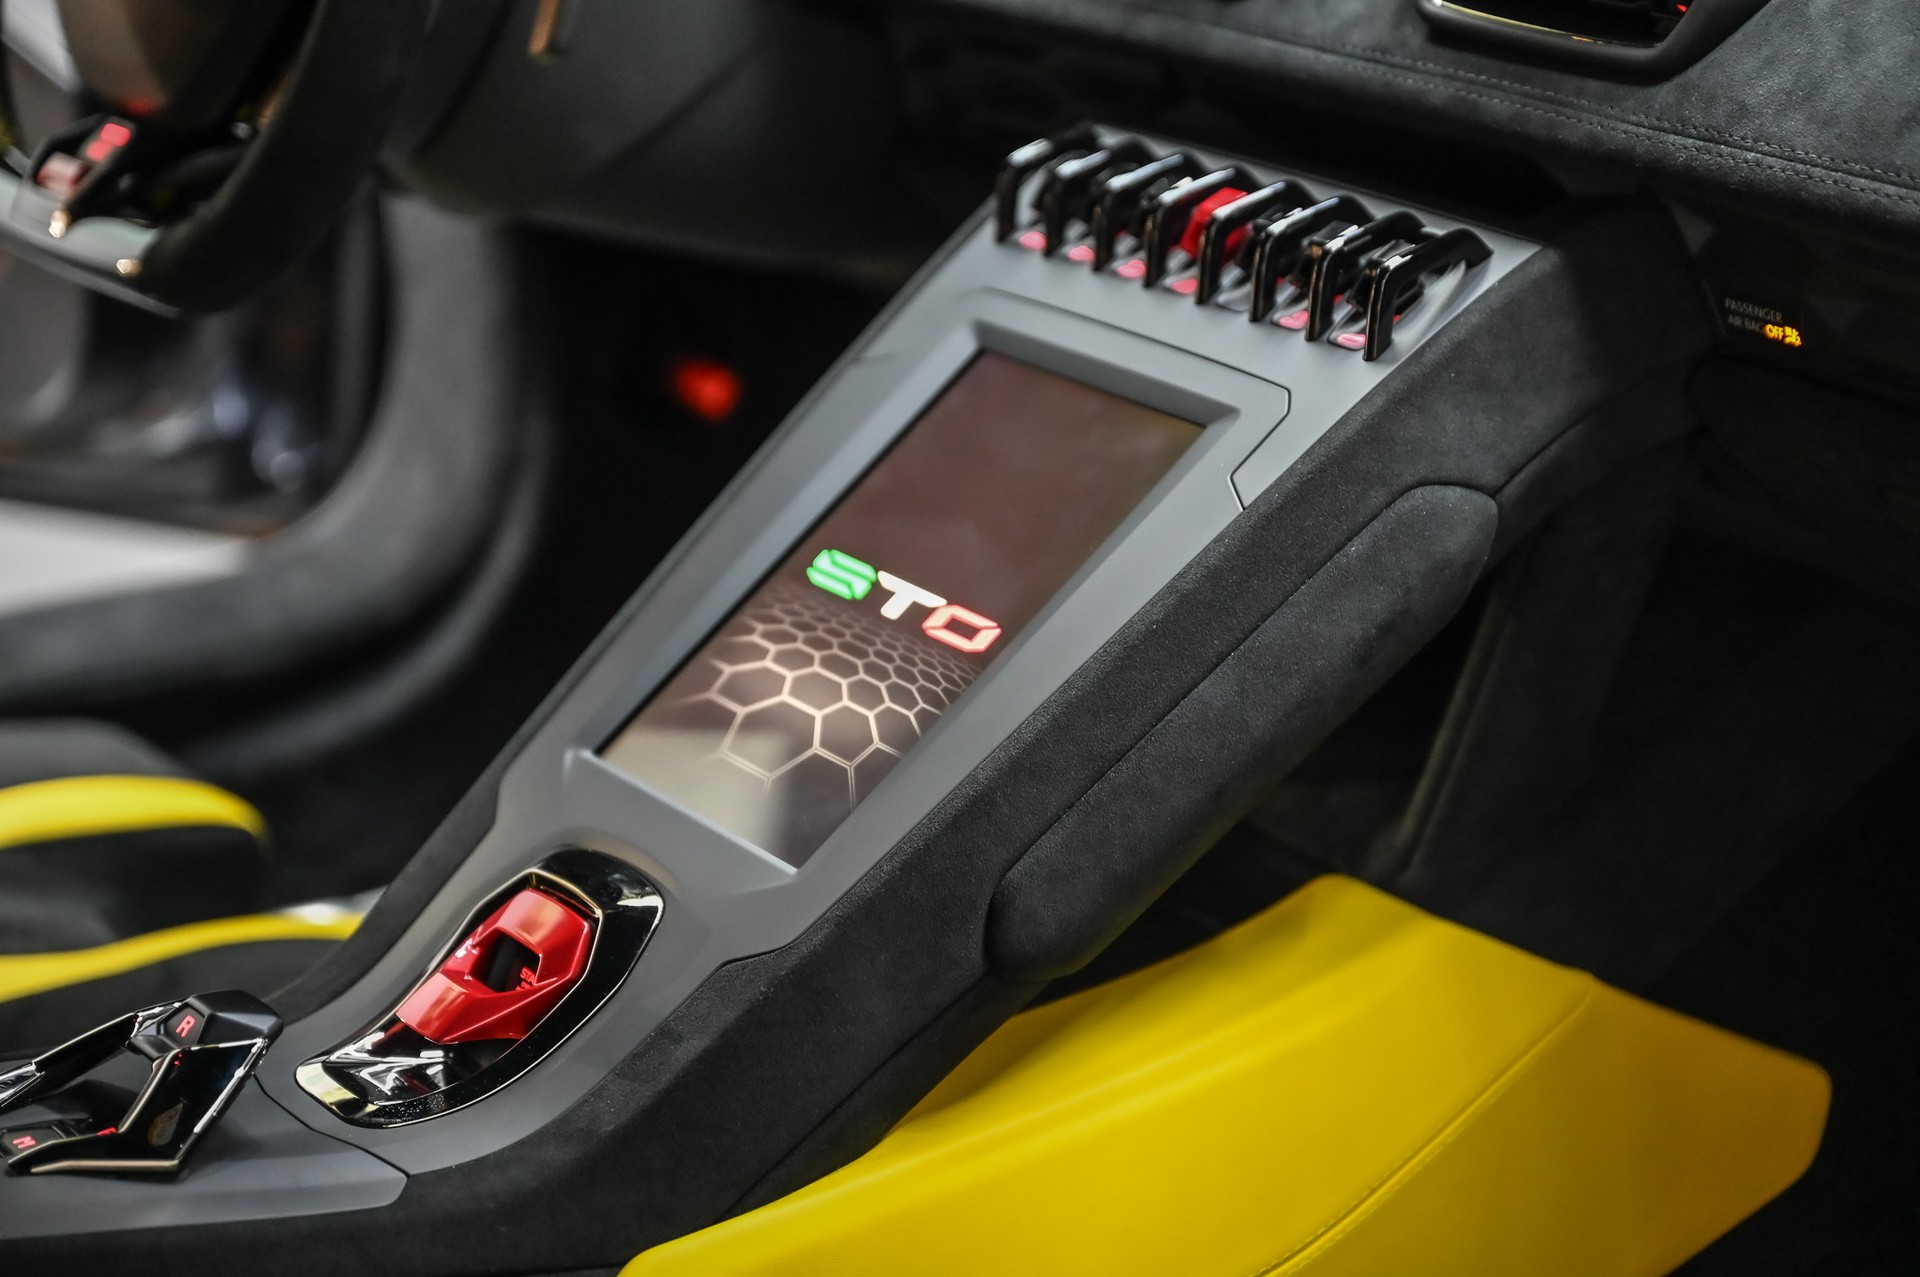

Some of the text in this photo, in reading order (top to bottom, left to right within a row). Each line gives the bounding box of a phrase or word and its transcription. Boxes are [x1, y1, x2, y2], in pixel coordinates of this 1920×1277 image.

[1725, 297, 1782, 323] PASSENGER
[1728, 315, 1743, 329] AIR
[1764, 323, 1784, 341] OFF
[806, 549, 1002, 653] STO
[175, 1014, 196, 1038] R
[12, 1135, 37, 1149] M
